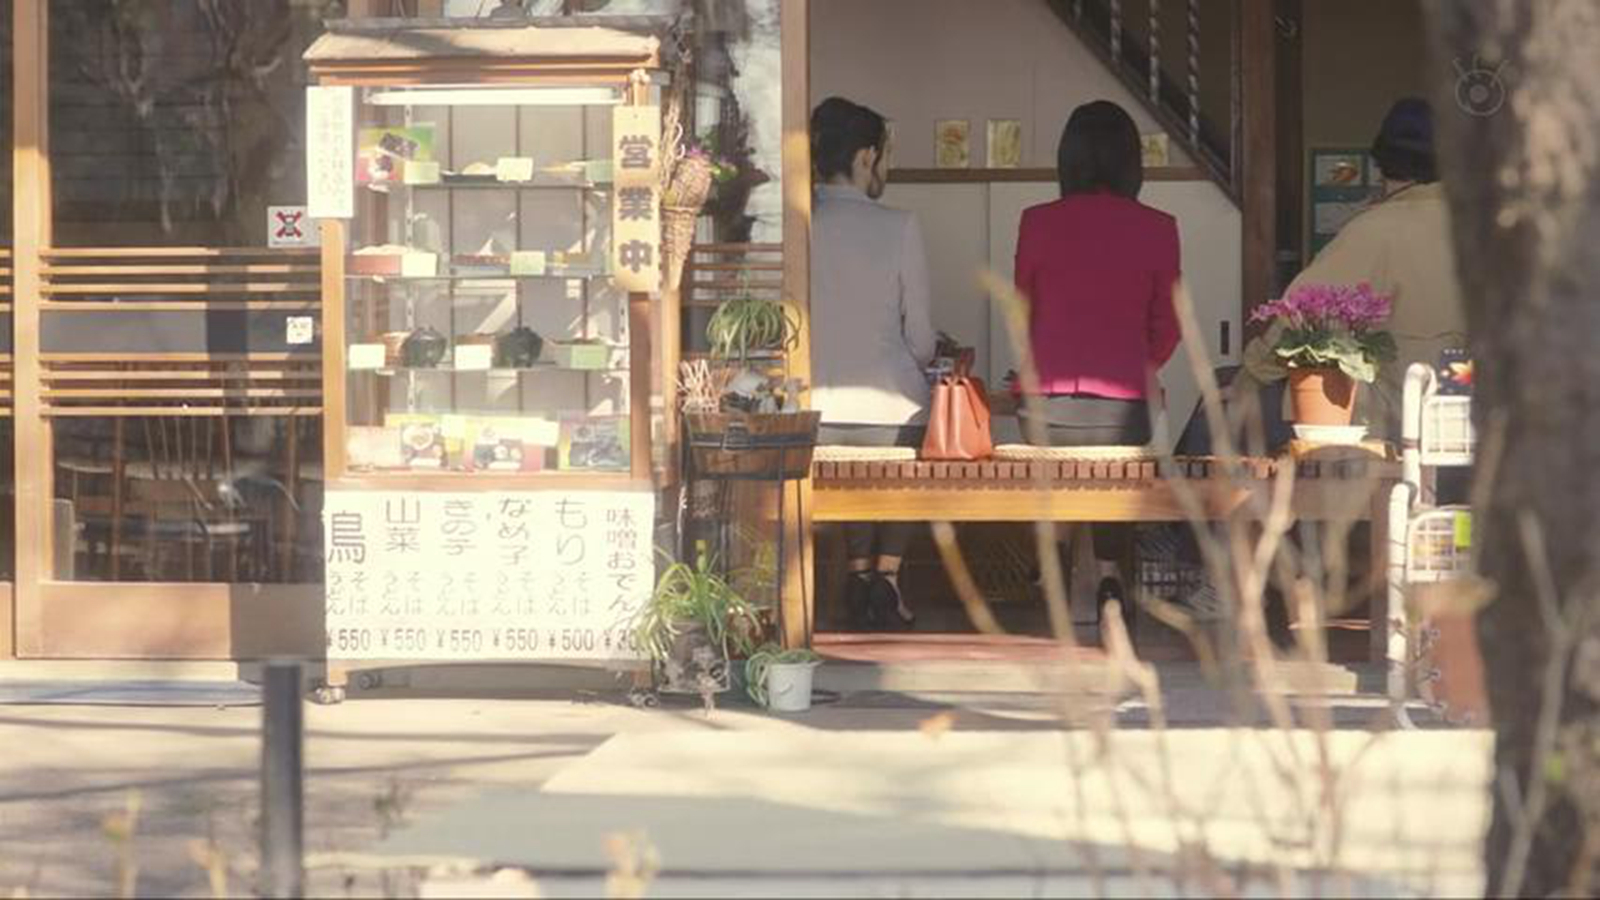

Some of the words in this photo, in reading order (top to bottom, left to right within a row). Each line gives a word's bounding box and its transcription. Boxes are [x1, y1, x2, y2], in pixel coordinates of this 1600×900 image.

[620, 135, 654, 272] 営業中
[327, 510, 366, 564] 鳥
[385, 496, 421, 553] 山菜
[440, 499, 477, 556] きの子
[497, 498, 533, 565] なめ子
[555, 498, 588, 566] もり
[606, 508, 637, 611] 味噌おでん
